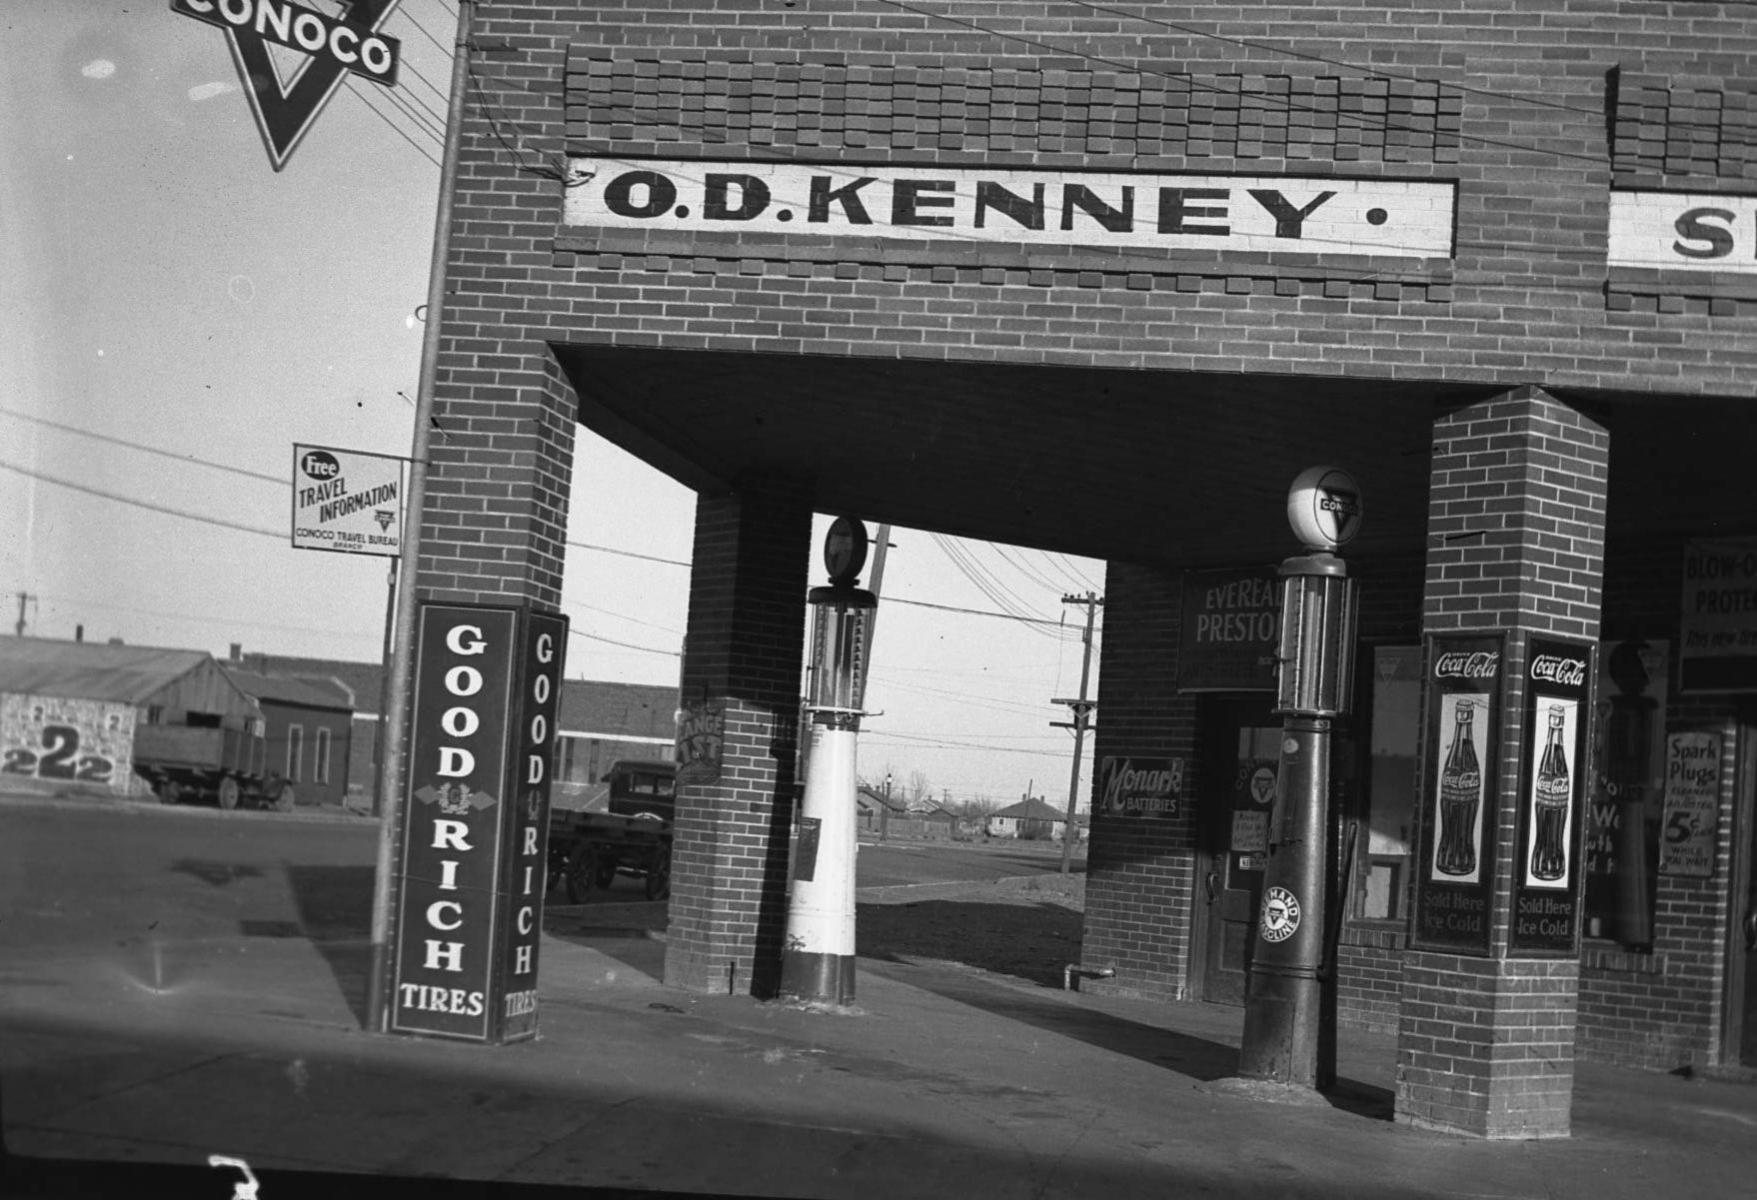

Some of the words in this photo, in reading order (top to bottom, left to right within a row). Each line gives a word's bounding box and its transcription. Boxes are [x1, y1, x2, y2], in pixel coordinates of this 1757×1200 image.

[306, 455, 337, 477] Free
[299, 477, 348, 509] TRAVEL
[320, 481, 397, 524] INFORMATION
[296, 528, 335, 540] CONOCO
[337, 531, 367, 544] TRAVEL
[1197, 612, 1279, 642] PRESTO
[1435, 652, 1499, 678] Coca-Cola
[1531, 654, 1586, 686] Coca-Cola
[1671, 738, 1716, 759] Spark
[1101, 758, 1181, 811] Monark
[1670, 760, 1716, 786] Plugs
[1127, 797, 1177, 813] BATTERIES
[1519, 896, 1544, 914] Sold
[1546, 898, 1572, 915] Here
[1448, 913, 1480, 932] Cold
[1517, 917, 1537, 935] Ice
[1539, 918, 1568, 936] Cold
[400, 982, 485, 1017] TIRES
